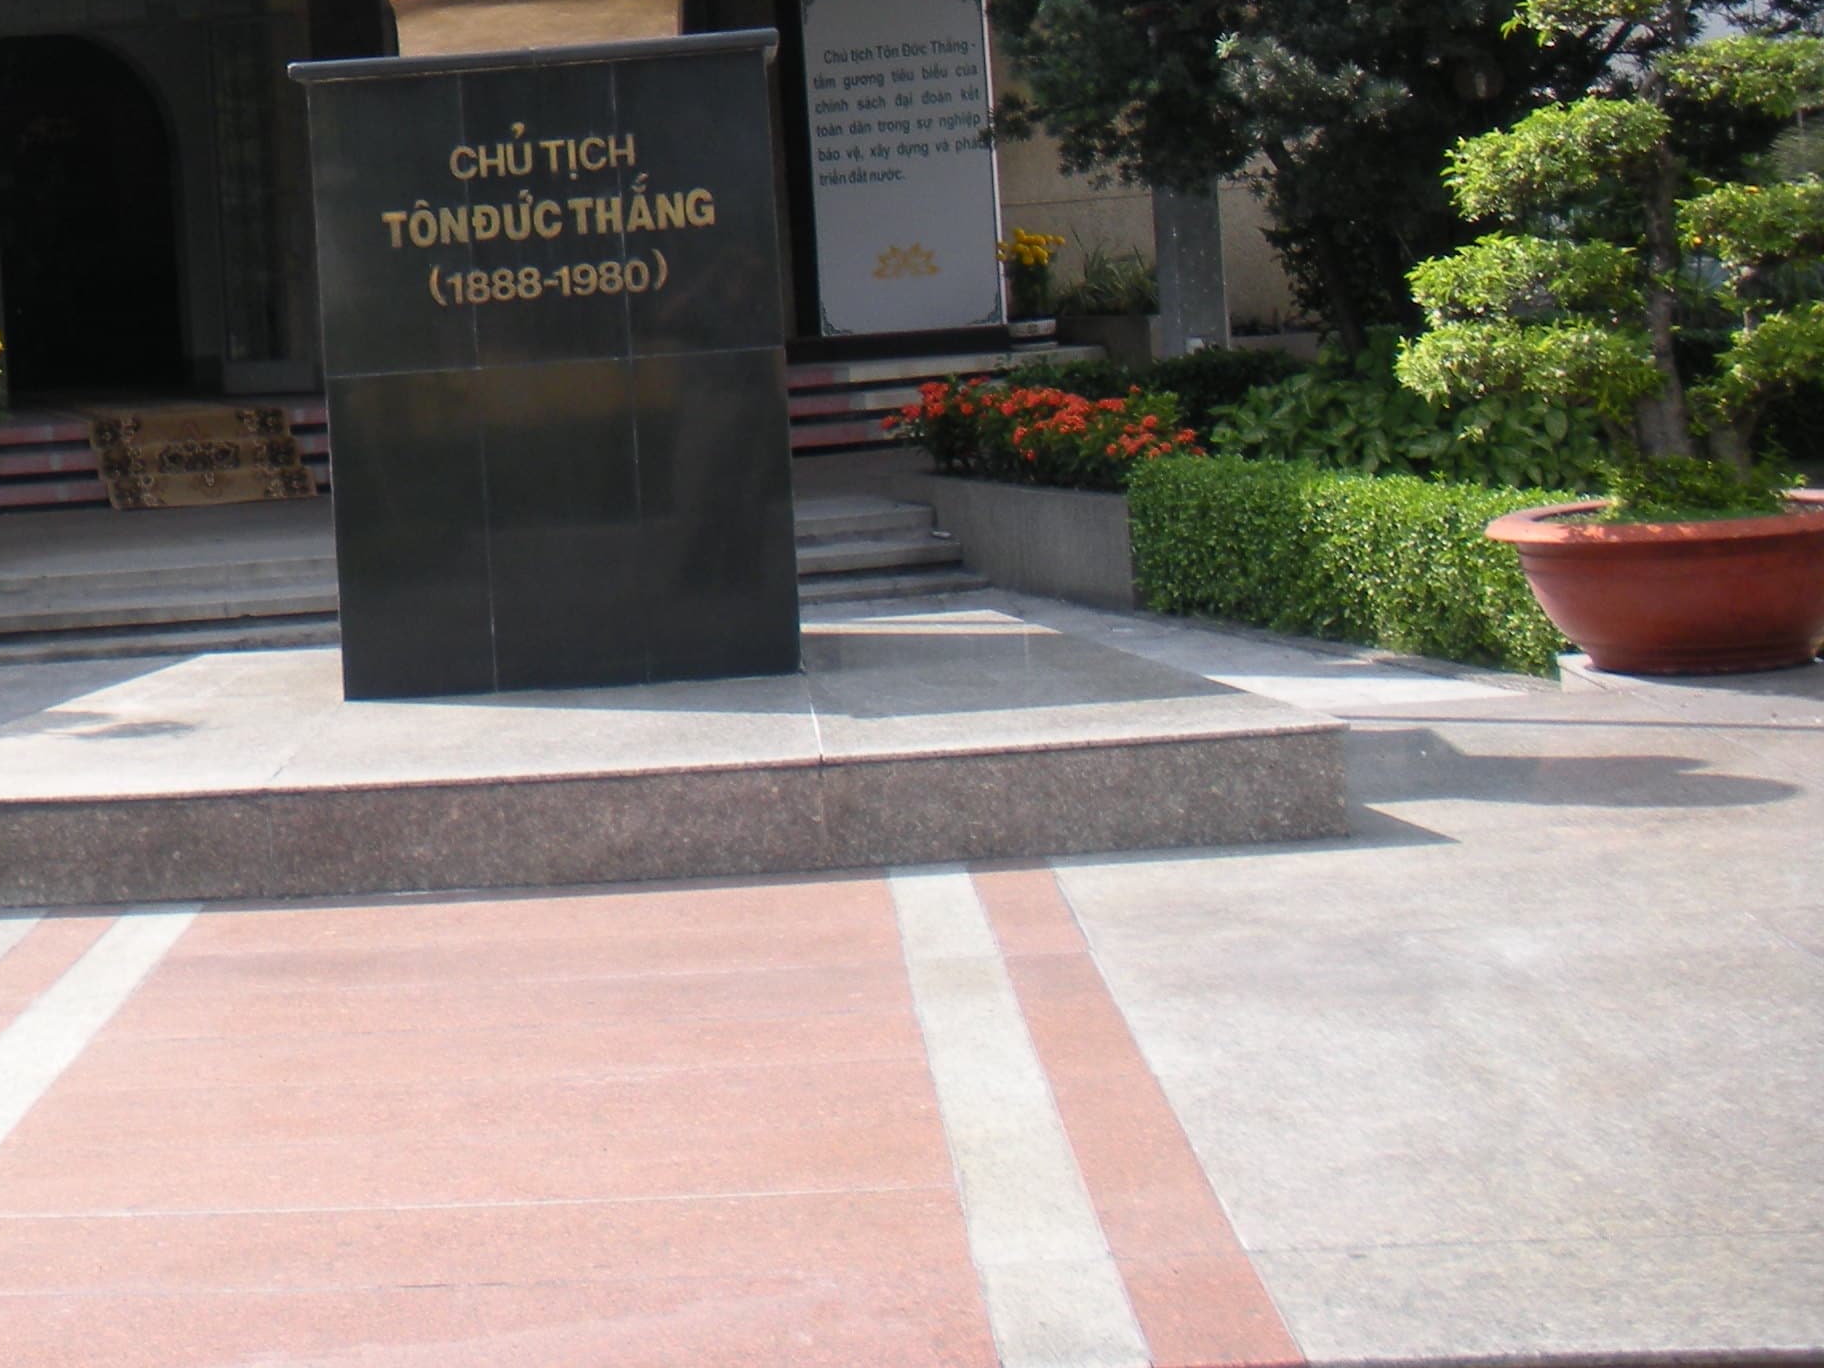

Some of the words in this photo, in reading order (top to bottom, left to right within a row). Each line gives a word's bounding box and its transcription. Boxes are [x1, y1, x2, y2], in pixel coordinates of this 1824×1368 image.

[449, 121, 533, 181] CHỦ
[539, 133, 636, 180] TỊCH
[567, 172, 717, 235] THẮNG
[428, 247, 669, 307] (1888-1980)
